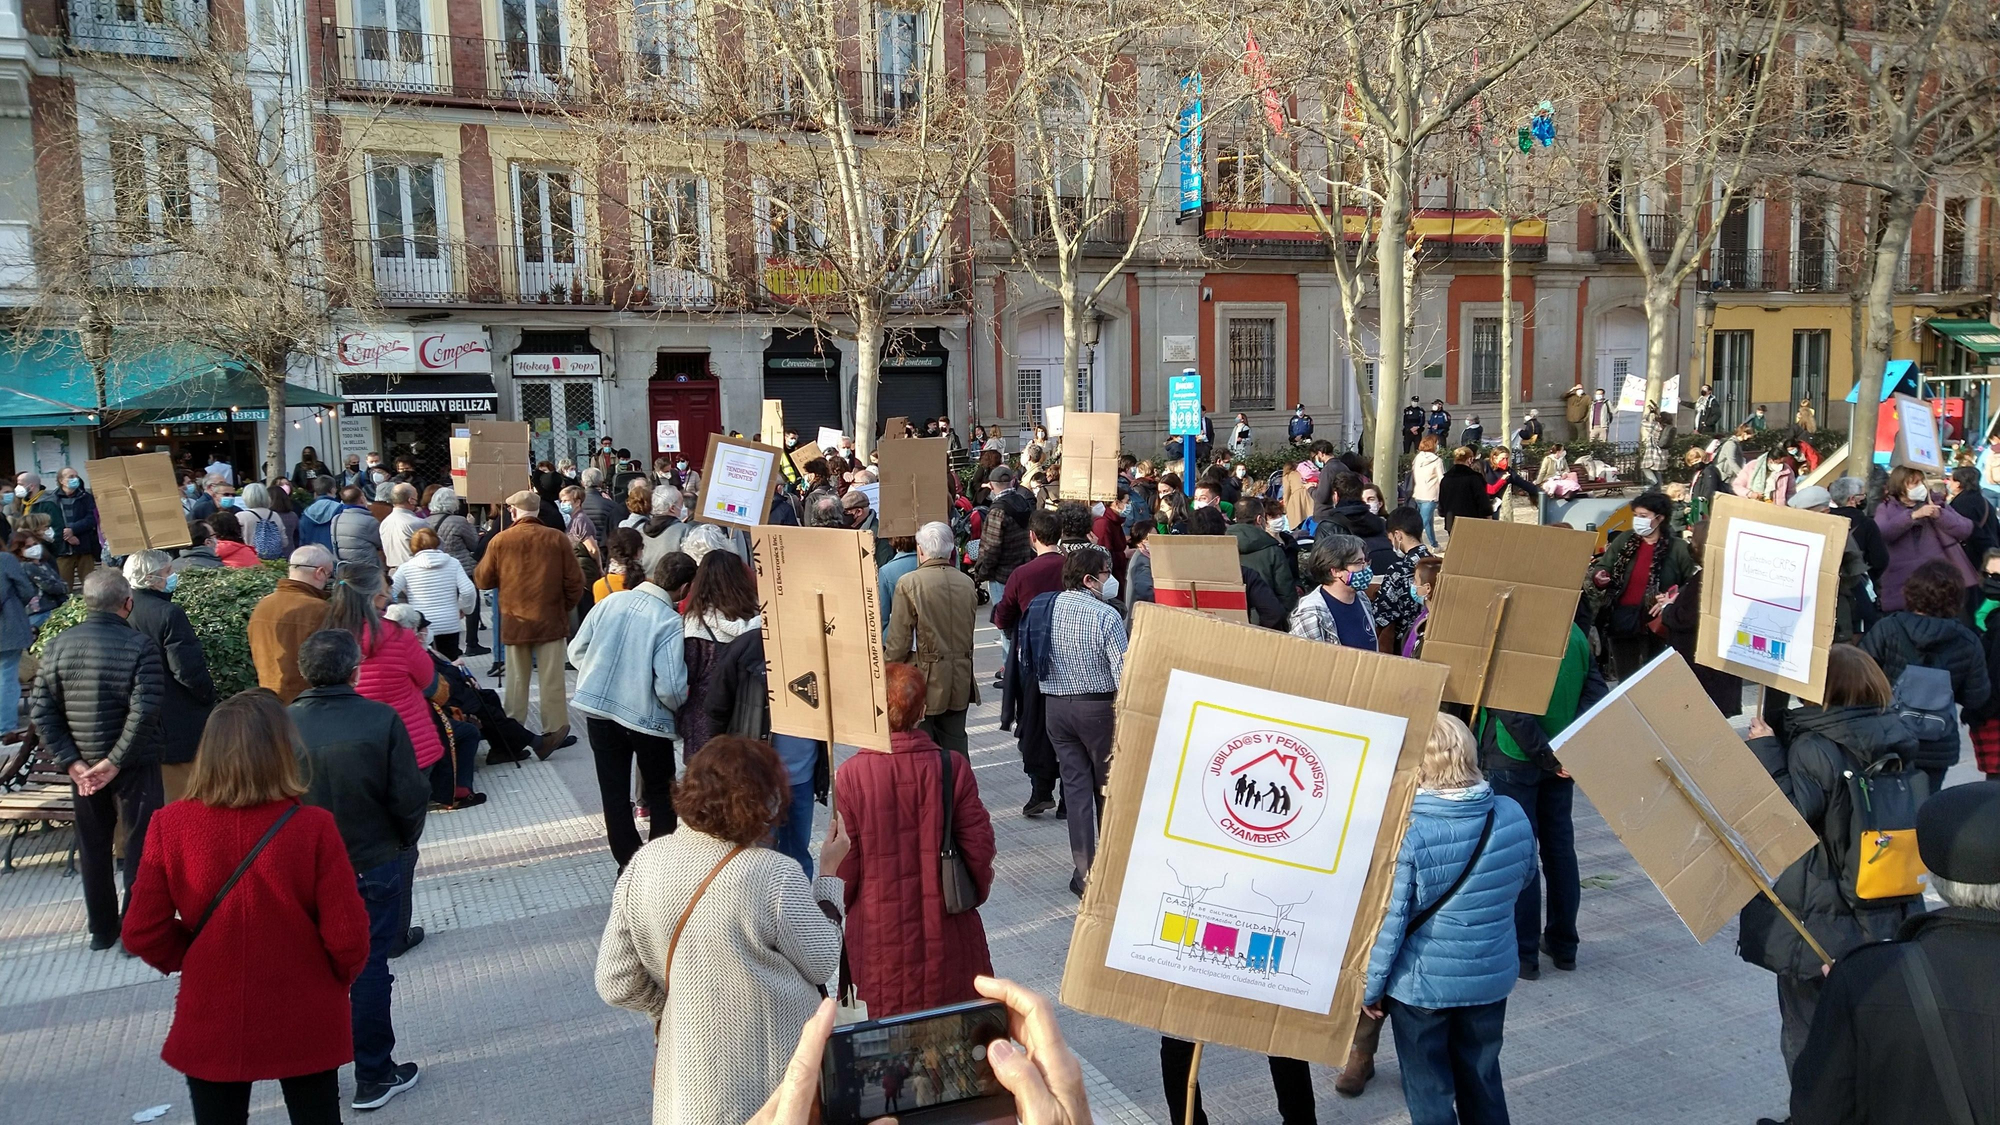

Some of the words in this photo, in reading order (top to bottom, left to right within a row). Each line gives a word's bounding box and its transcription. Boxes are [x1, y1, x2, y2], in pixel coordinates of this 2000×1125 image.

[338, 332, 410, 369] Comper
[419, 334, 485, 369] Comper
[516, 362, 551, 371] Hokey
[178, 412, 194, 420] DE
[352, 401, 375, 414] ART.
[376, 400, 438, 413] PELUQUERIA
[440, 400, 446, 412] Y
[448, 400, 491, 412] BELLEZA
[726, 466, 757, 476] TENDIENDO
[728, 472, 752, 482] PUENTES
[777, 586, 783, 595] LG
[872, 646, 881, 680] CLAMP
[1210, 734, 1262, 776] JUBILAD@S
[1265, 734, 1274, 743] Y
[1276, 736, 1324, 798] PENSIONISTAS
[1166, 896, 1194, 908] CASA
[1210, 909, 1238, 919] CULTURA
[1235, 920, 1297, 938] CIUDADANA
[1130, 952, 1146, 960] Casa
[1158, 958, 1181, 970] Cultura
[1189, 965, 1231, 980] Participación
[1232, 975, 1266, 988] Ciudadana
[1268, 982, 1276, 990] de
[1278, 984, 1310, 996] Chamberí
